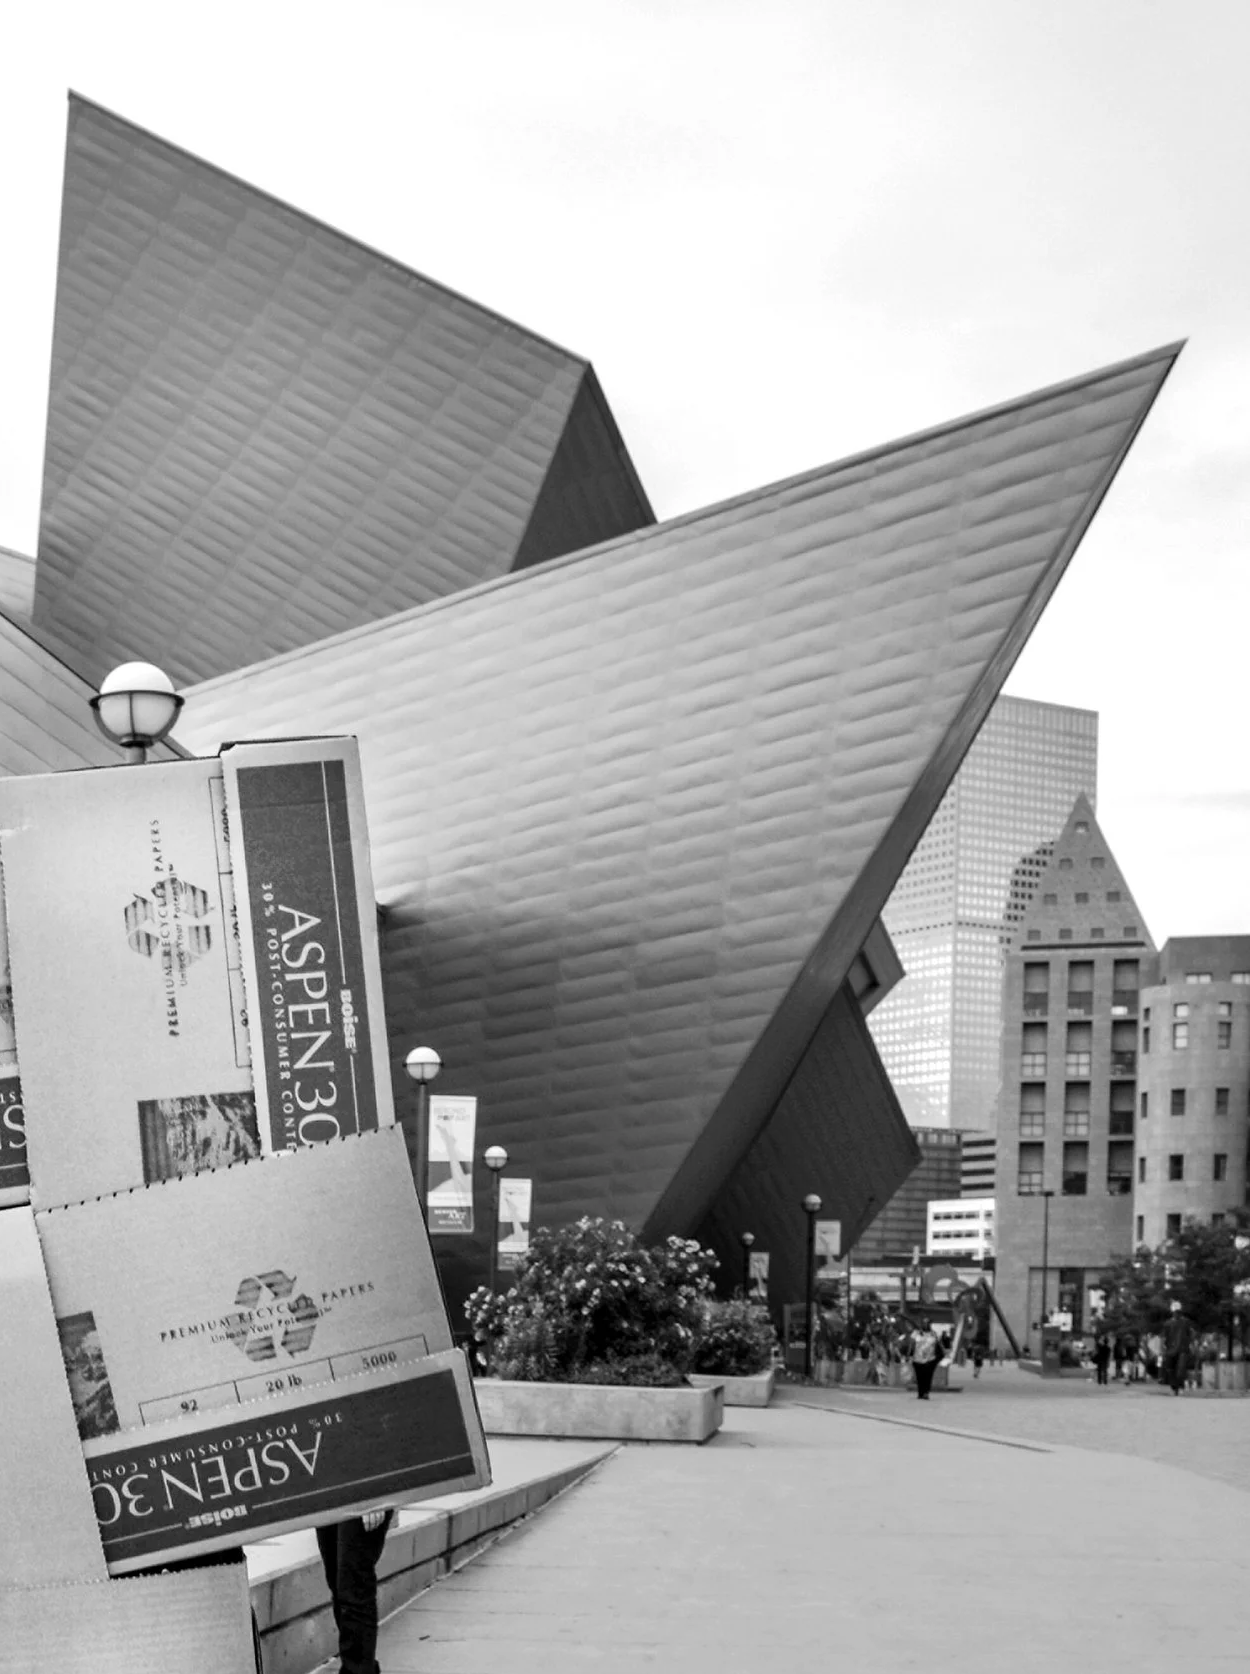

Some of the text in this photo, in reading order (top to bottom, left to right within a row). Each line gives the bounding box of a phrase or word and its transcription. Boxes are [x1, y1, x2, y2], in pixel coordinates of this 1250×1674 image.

[149, 819, 165, 873] PAPERS
[164, 961, 180, 1037] PREMIUM
[261, 882, 299, 1151] 30% POST-CONSUMER CONTE
[278, 904, 341, 1146] ASPEN 30
[159, 1318, 232, 1342] PREMIUM
[321, 1281, 376, 1302] PAPERS
[249, 1322, 274, 1335] Your
[265, 1374, 303, 1393] 20 lb
[361, 1350, 398, 1370] 5000
[180, 1399, 198, 1412] 92
[91, 1411, 343, 1482] 30% POST-CONSUMER CONT
[90, 1431, 323, 1526] ASPEN 30
